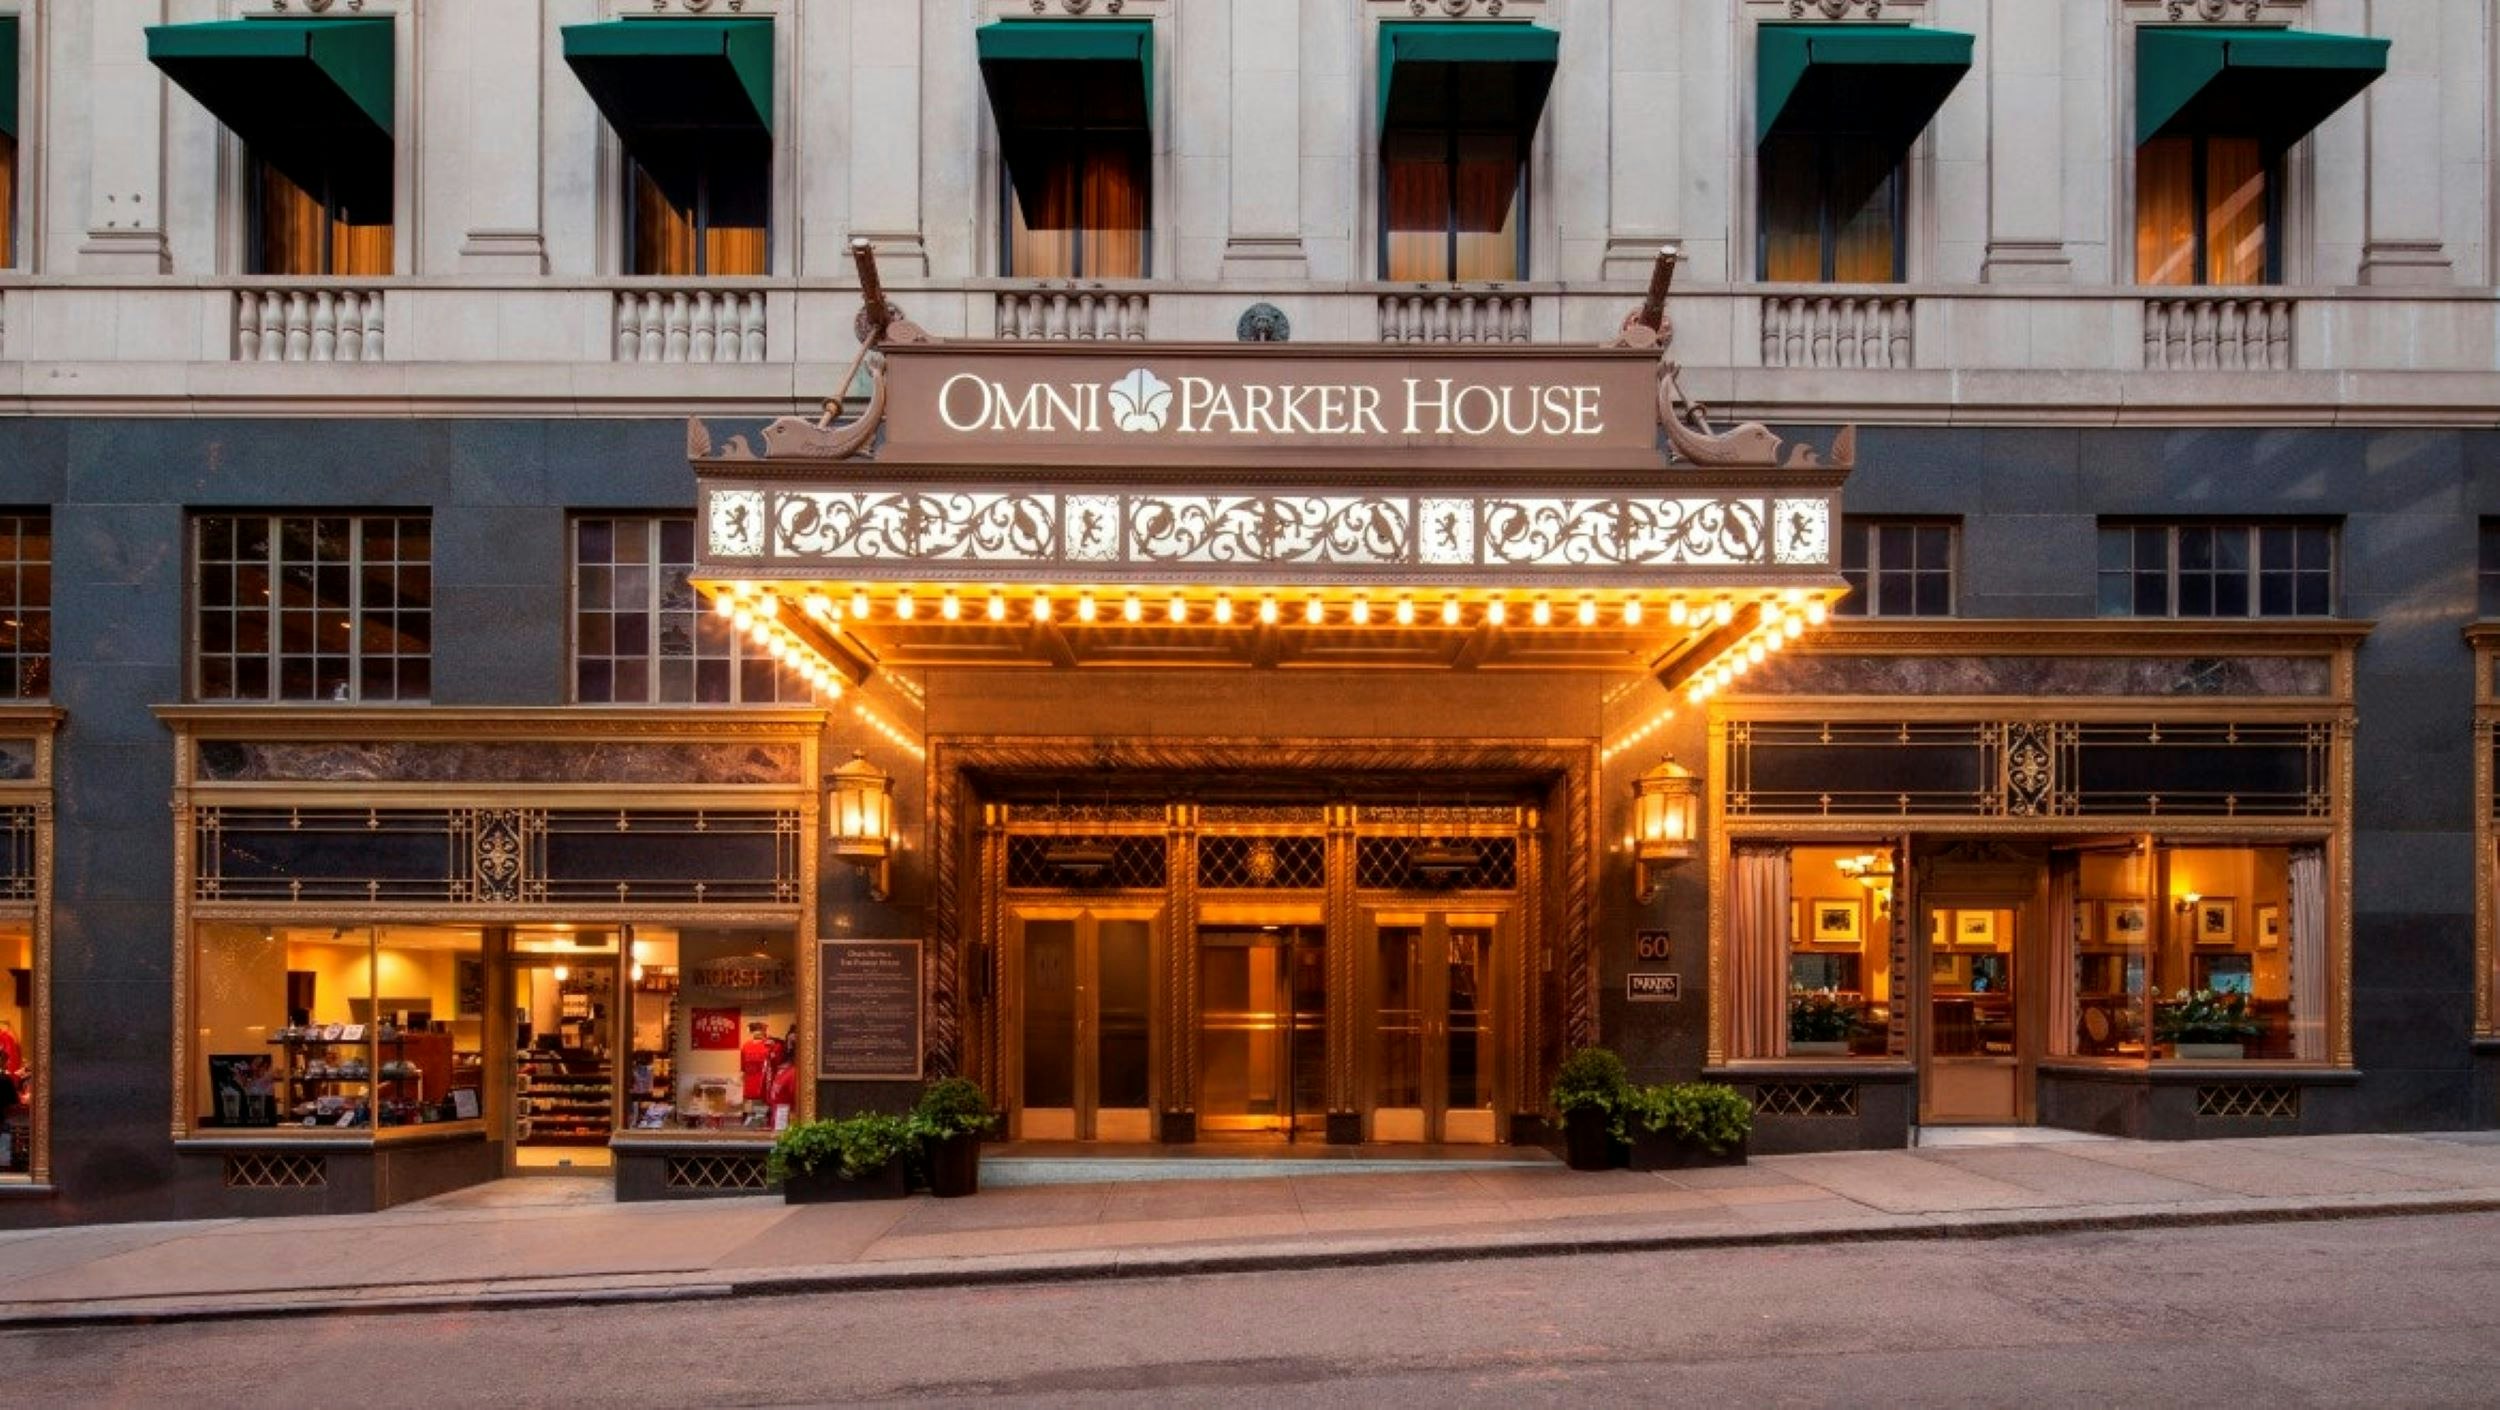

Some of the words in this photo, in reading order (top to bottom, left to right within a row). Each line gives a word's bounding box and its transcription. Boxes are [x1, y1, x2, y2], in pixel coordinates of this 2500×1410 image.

[938, 372, 1101, 432] OMNI
[1176, 376, 1389, 434] PARKER
[1400, 377, 1605, 436] HOUSE
[1639, 935, 1669, 958] 60
